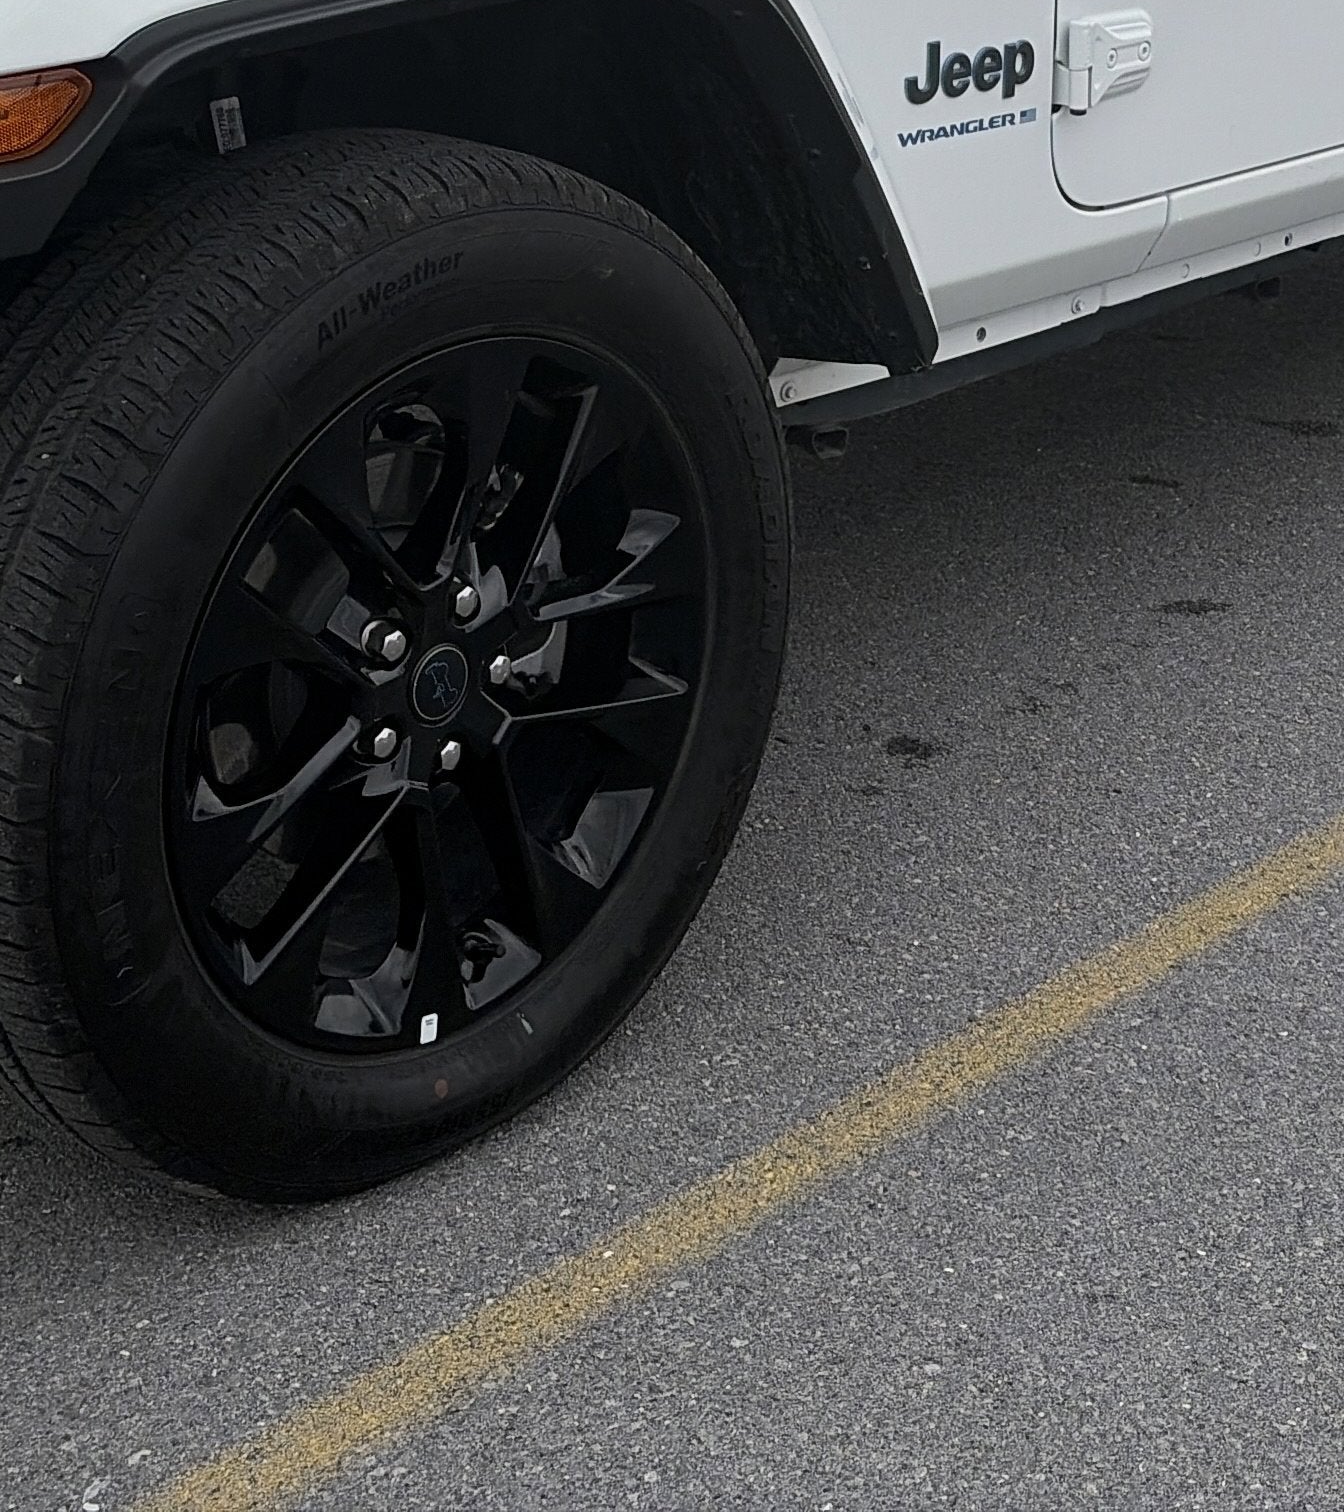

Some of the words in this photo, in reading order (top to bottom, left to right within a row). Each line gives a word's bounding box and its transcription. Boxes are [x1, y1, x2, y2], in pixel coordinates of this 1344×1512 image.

[903, 39, 1036, 105] Jeep
[897, 112, 1017, 148] WRANGLER
[317, 250, 464, 352] All-Weather
